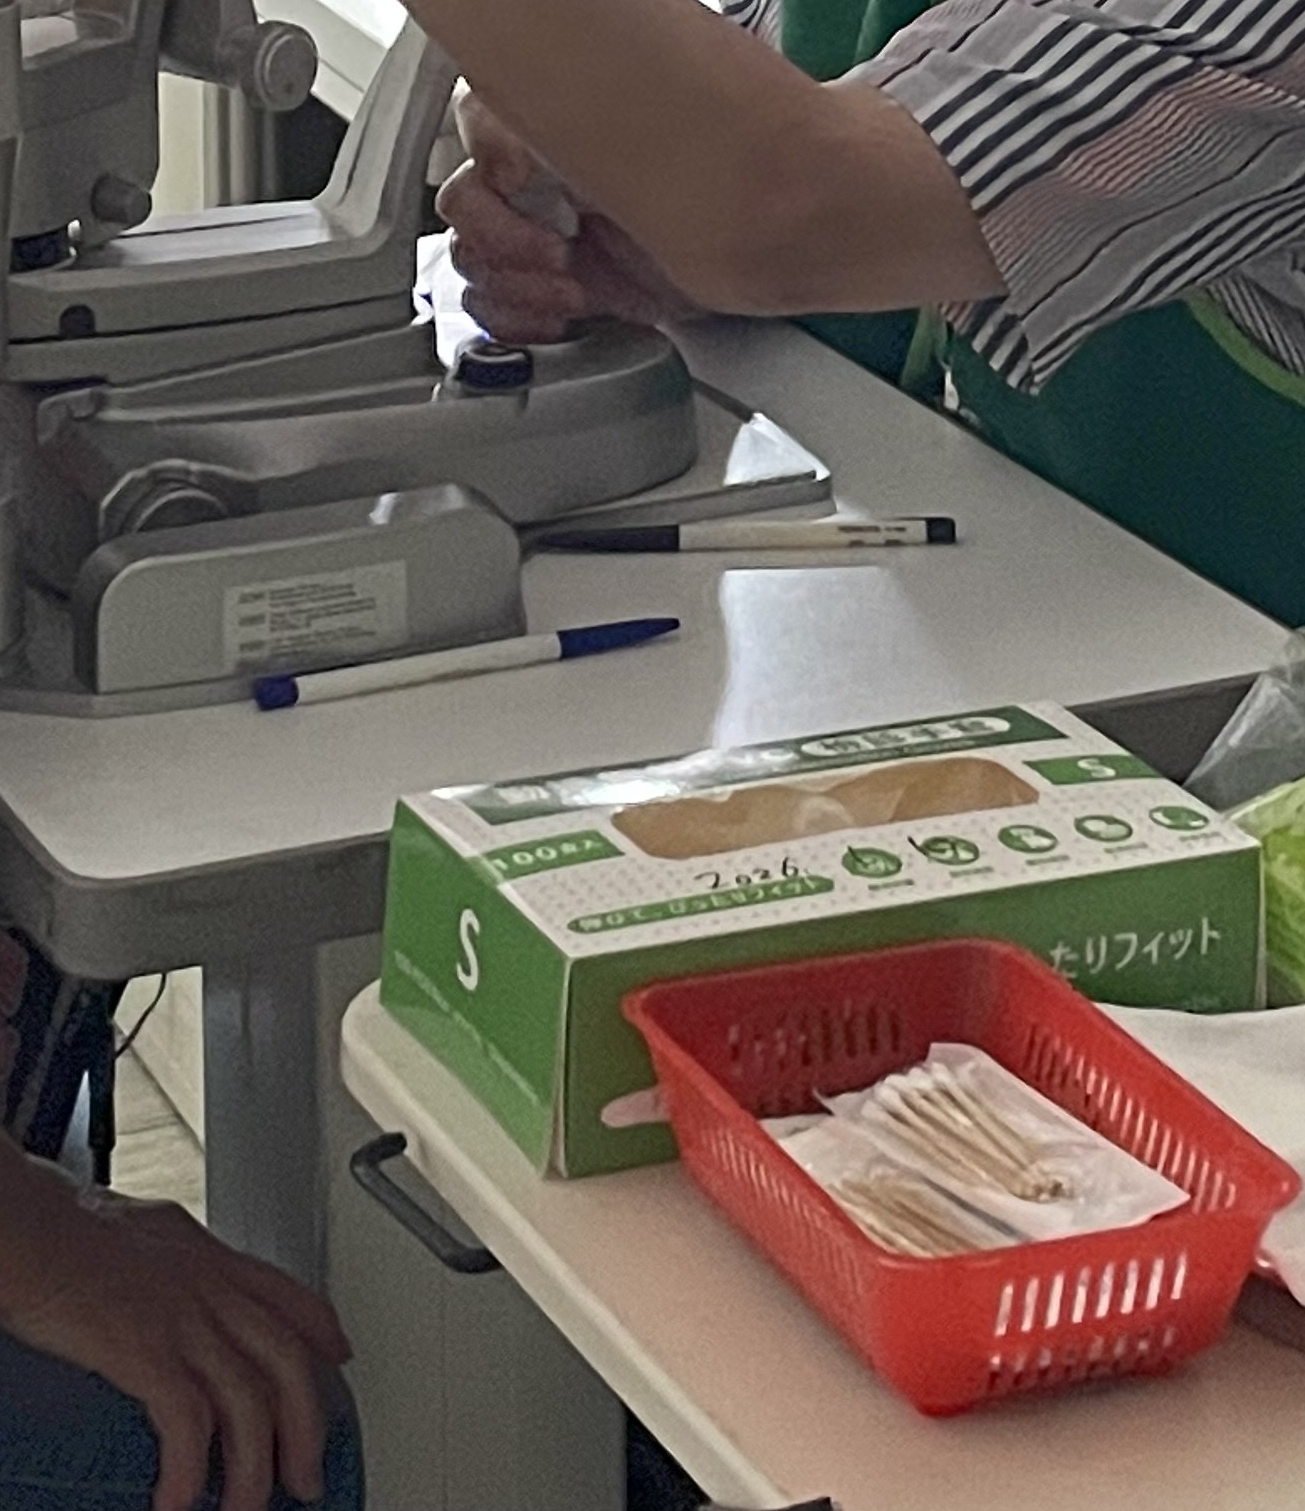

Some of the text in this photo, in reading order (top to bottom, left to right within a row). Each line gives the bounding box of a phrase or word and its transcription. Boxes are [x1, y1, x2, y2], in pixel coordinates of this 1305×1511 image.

[1077, 757, 1116, 779] S
[456, 908, 480, 992] S
[1049, 916, 1221, 979] たりフィット
